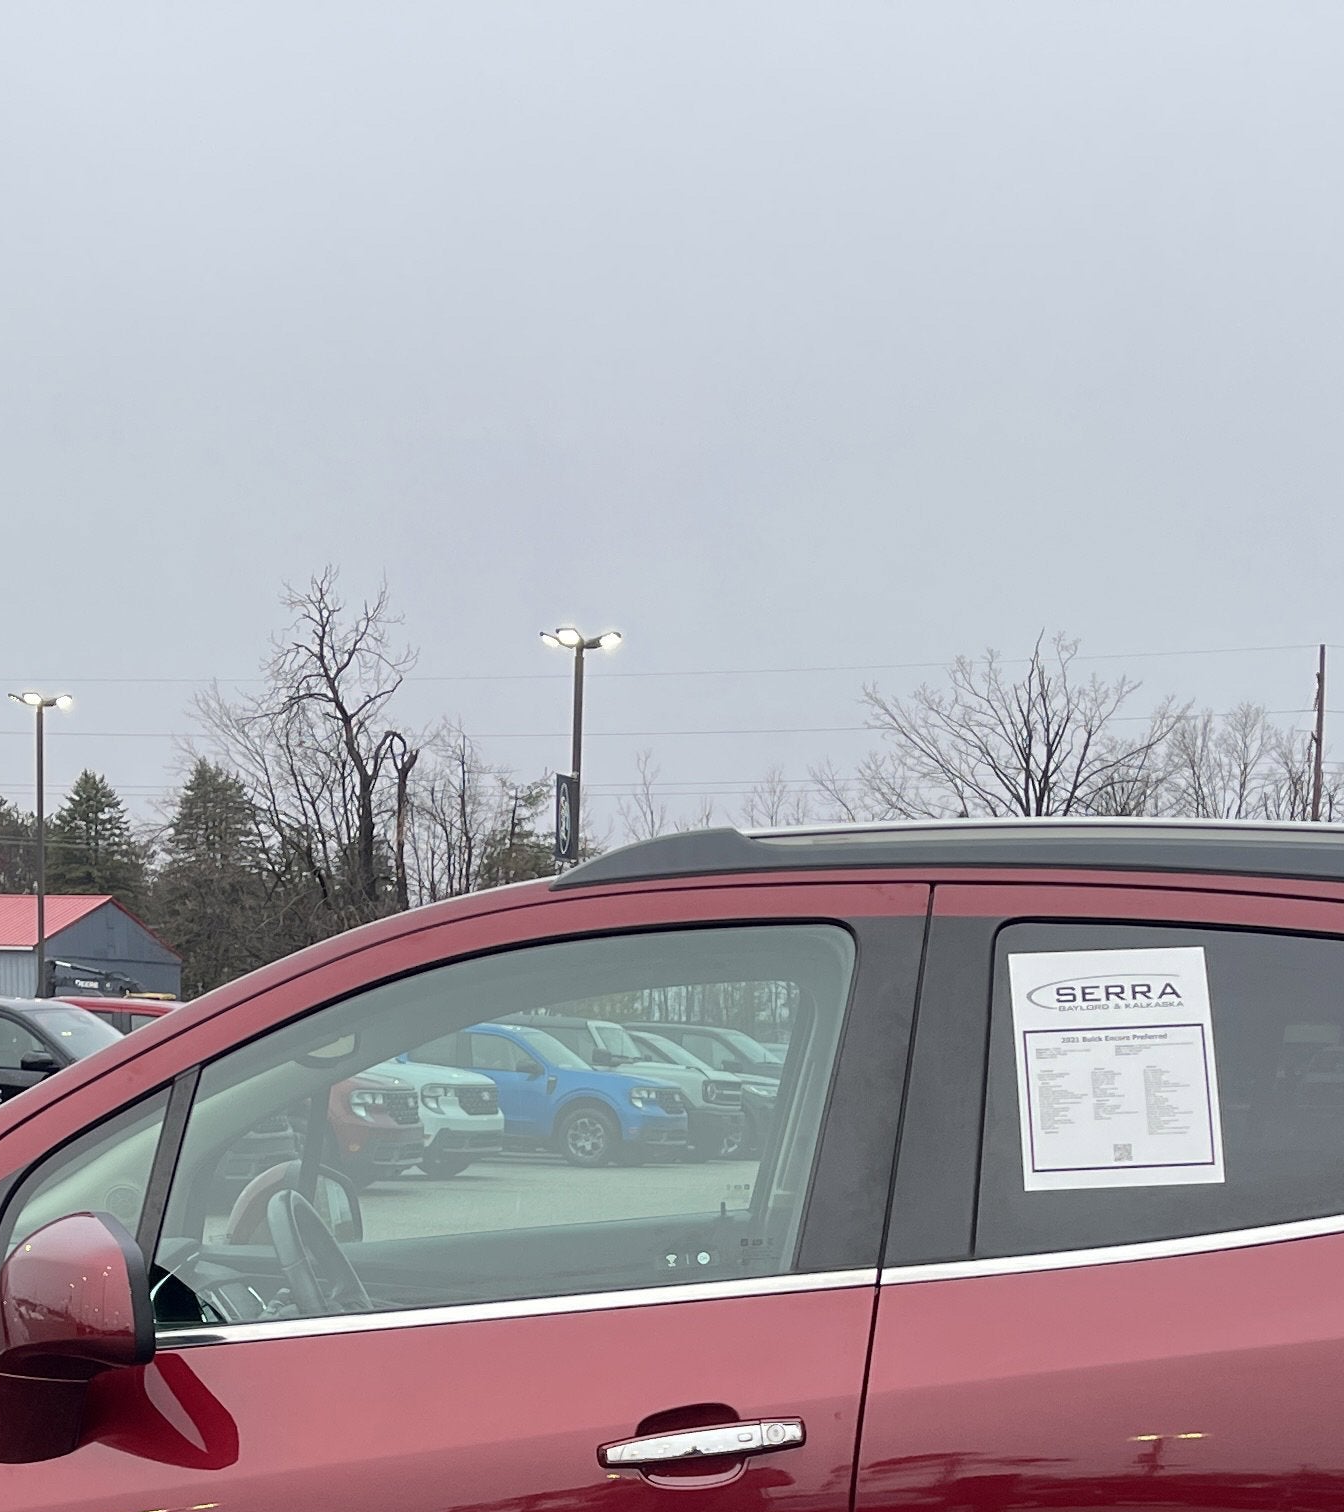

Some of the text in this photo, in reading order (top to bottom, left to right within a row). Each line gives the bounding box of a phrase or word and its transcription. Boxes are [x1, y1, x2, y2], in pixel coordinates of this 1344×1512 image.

[1055, 982, 1182, 1003] SERRA
[1124, 1000, 1185, 1010] KALKASKA
[1082, 1035, 1103, 1043] Buick
[1105, 1033, 1131, 1042] Encore
[1132, 1032, 1168, 1041] Preferred
